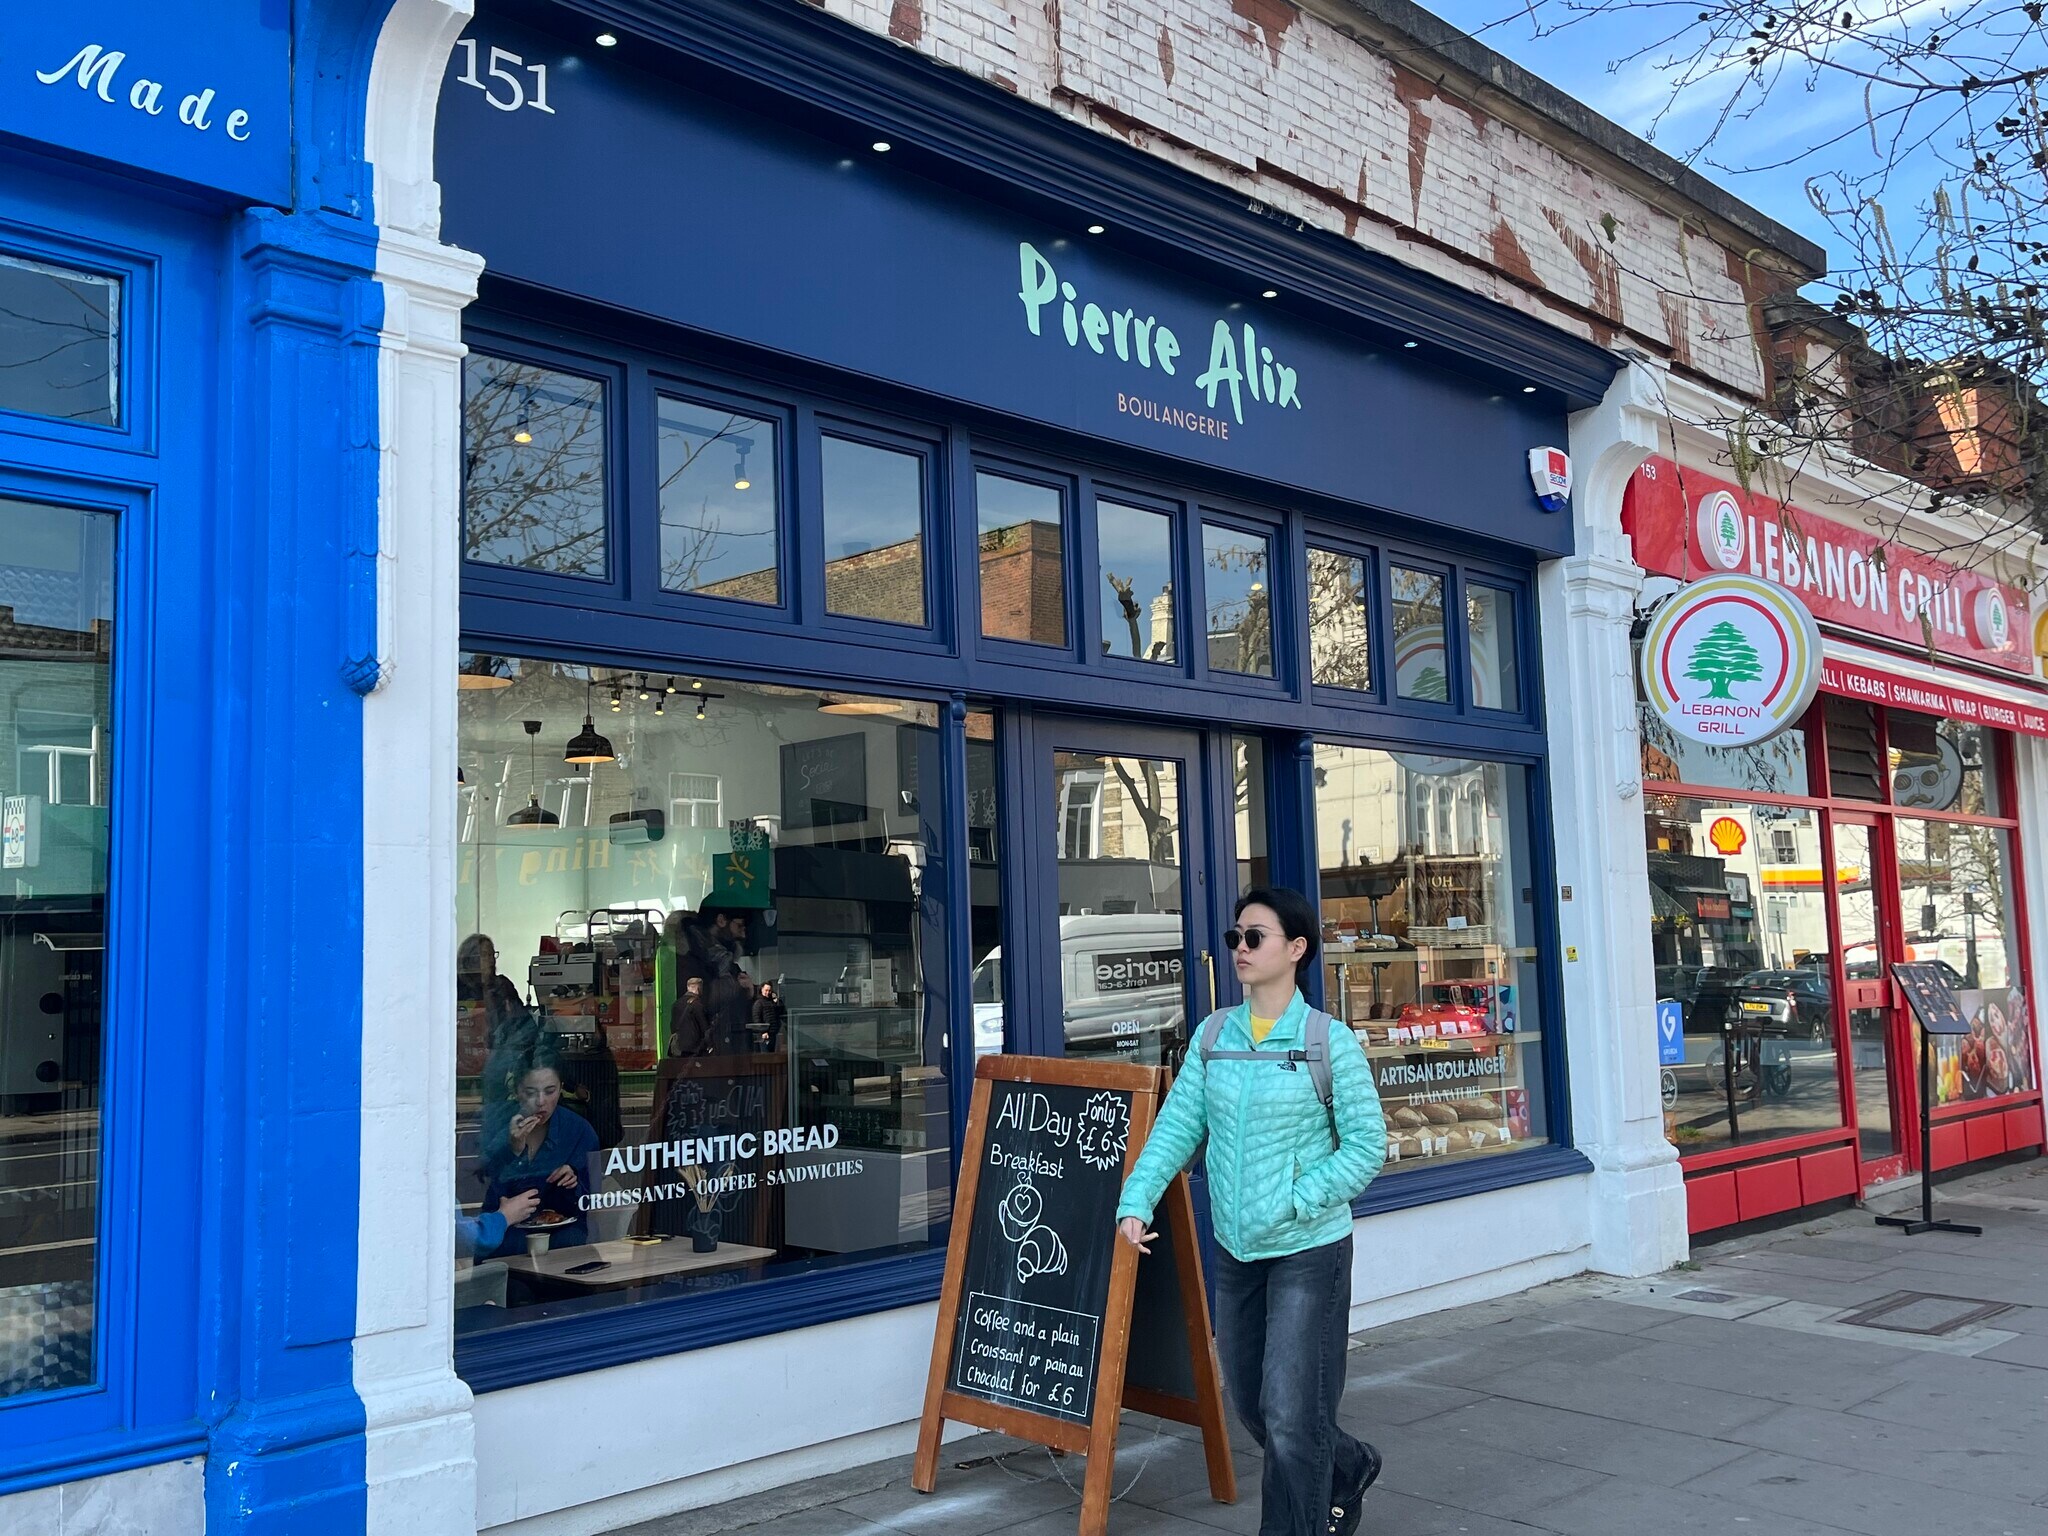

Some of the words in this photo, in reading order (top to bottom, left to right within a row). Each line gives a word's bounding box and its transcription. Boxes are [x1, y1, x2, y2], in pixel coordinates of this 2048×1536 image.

[36, 44, 250, 142] Made
[456, 38, 556, 115] 151
[1018, 241, 1181, 376] Pierre
[1195, 319, 1302, 425] Alix
[1117, 392, 1230, 441] BOULANGERIE
[1640, 462, 1657, 481] 153
[1747, 515, 1889, 616] LEBANON
[1899, 568, 1967, 639] GRILL
[1681, 703, 1761, 718] LEBANON
[1846, 673, 1887, 699] KEBABS
[1893, 685, 1946, 712] SHAWARMA
[1952, 697, 1977, 717] WRAP
[1982, 704, 2017, 725] BURGER
[2023, 714, 2047, 732] JUICE
[1697, 721, 1746, 736] GRILL
[1111, 1019, 1140, 1036] OPEN
[1379, 1062, 1435, 1087] ARTISAN
[1436, 1056, 1507, 1081] BOULANGER
[995, 1092, 1027, 1133] All
[1029, 1093, 1072, 1148] Day
[1089, 1102, 1117, 1127] only
[604, 1132, 757, 1177] AUTHENTIC
[762, 1123, 839, 1157] BREAD
[989, 1144, 1064, 1180] Breakfast
[577, 1181, 686, 1213] CROISSANTS
[696, 1171, 757, 1196] COFFEE
[766, 1159, 864, 1186] SANDWICHES
[974, 1307, 1010, 1332] Coffee
[1013, 1319, 1036, 1337] and
[1037, 1328, 1047, 1339] a
[1051, 1320, 1080, 1347] plain
[969, 1337, 1024, 1365] Croissant
[1028, 1354, 1042, 1367] or
[966, 1366, 1015, 1394] Chocolat
[1020, 1372, 1041, 1398] for
